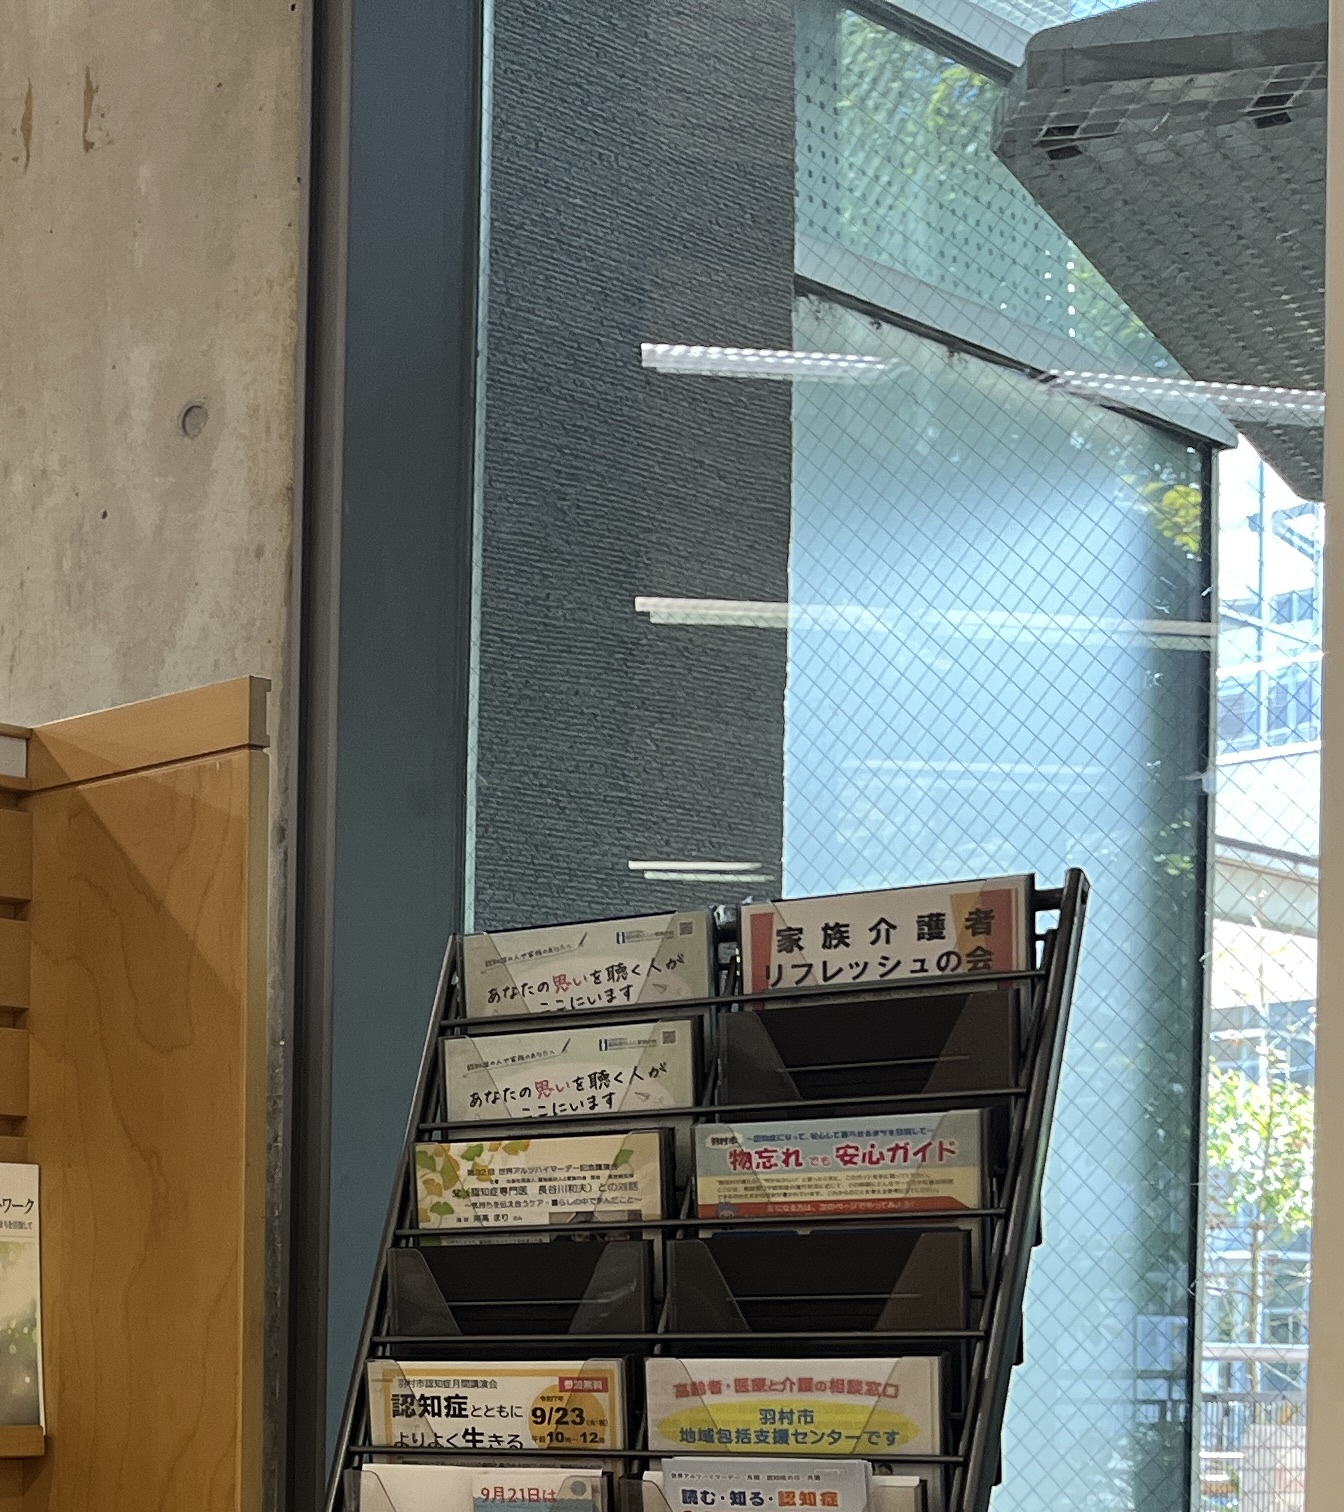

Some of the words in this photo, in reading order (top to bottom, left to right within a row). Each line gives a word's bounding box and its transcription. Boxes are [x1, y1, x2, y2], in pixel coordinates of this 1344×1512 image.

[776, 907, 997, 954] 家族介護者
[763, 945, 994, 987] リフレッシュの会
[487, 953, 685, 1004] あなたの思いを聴く人が
[469, 1062, 667, 1107] あなたの思いを聴く人が
[729, 1140, 958, 1170] 物忘れでも安心ガイド
[673, 1377, 900, 1399] 高齢者・医療と介護の相談窓口
[392, 1393, 523, 1419] 認知症とともに
[531, 1407, 585, 1425] 9/23
[759, 1409, 814, 1424] 羽村市
[394, 1427, 524, 1450] よりよく生きる
[680, 1428, 900, 1446] 地域包括支援センターです
[481, 1486, 556, 1504] 9月21日は
[681, 1489, 839, 1507] 読む・知る・認知症
